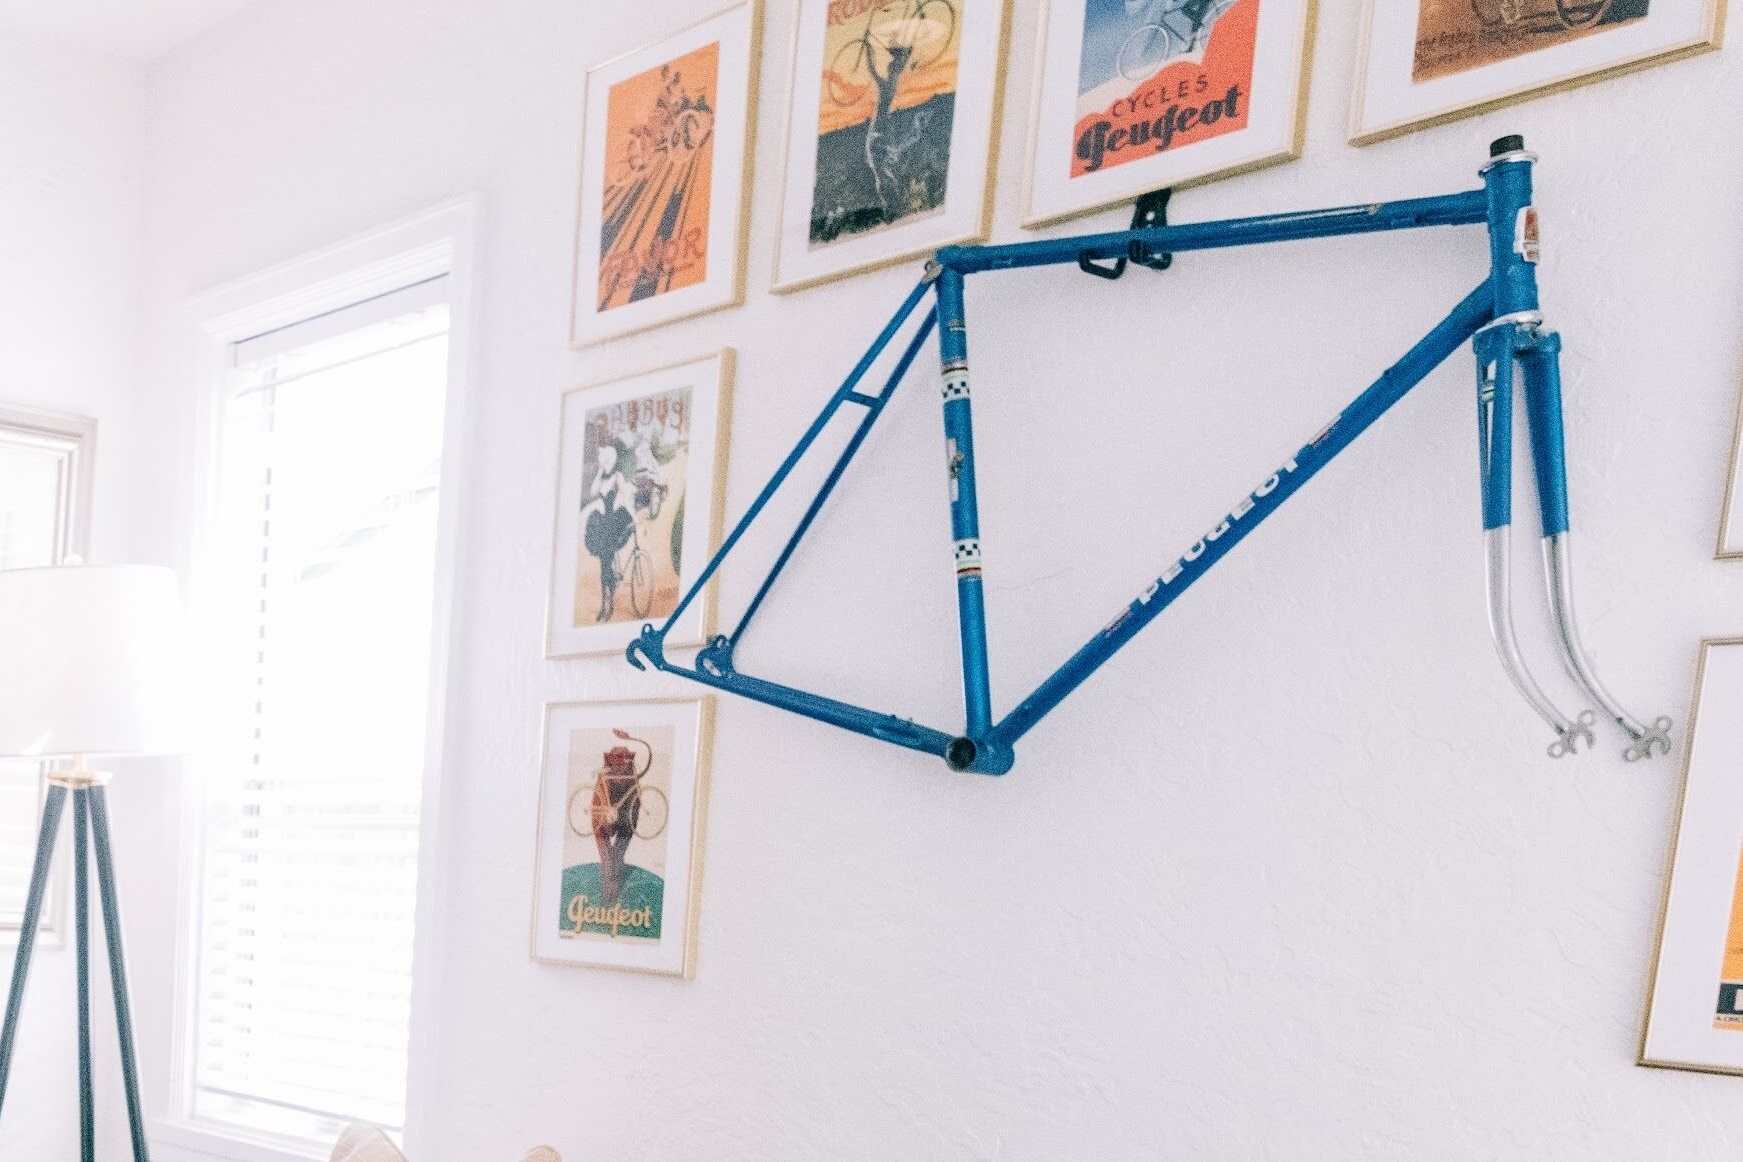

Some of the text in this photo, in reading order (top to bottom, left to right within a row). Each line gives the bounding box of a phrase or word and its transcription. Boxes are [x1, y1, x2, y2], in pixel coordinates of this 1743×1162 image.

[1113, 74, 1209, 117] CYCLES
[1076, 84, 1243, 172] Peugeot
[567, 894, 652, 937] Peugeot
